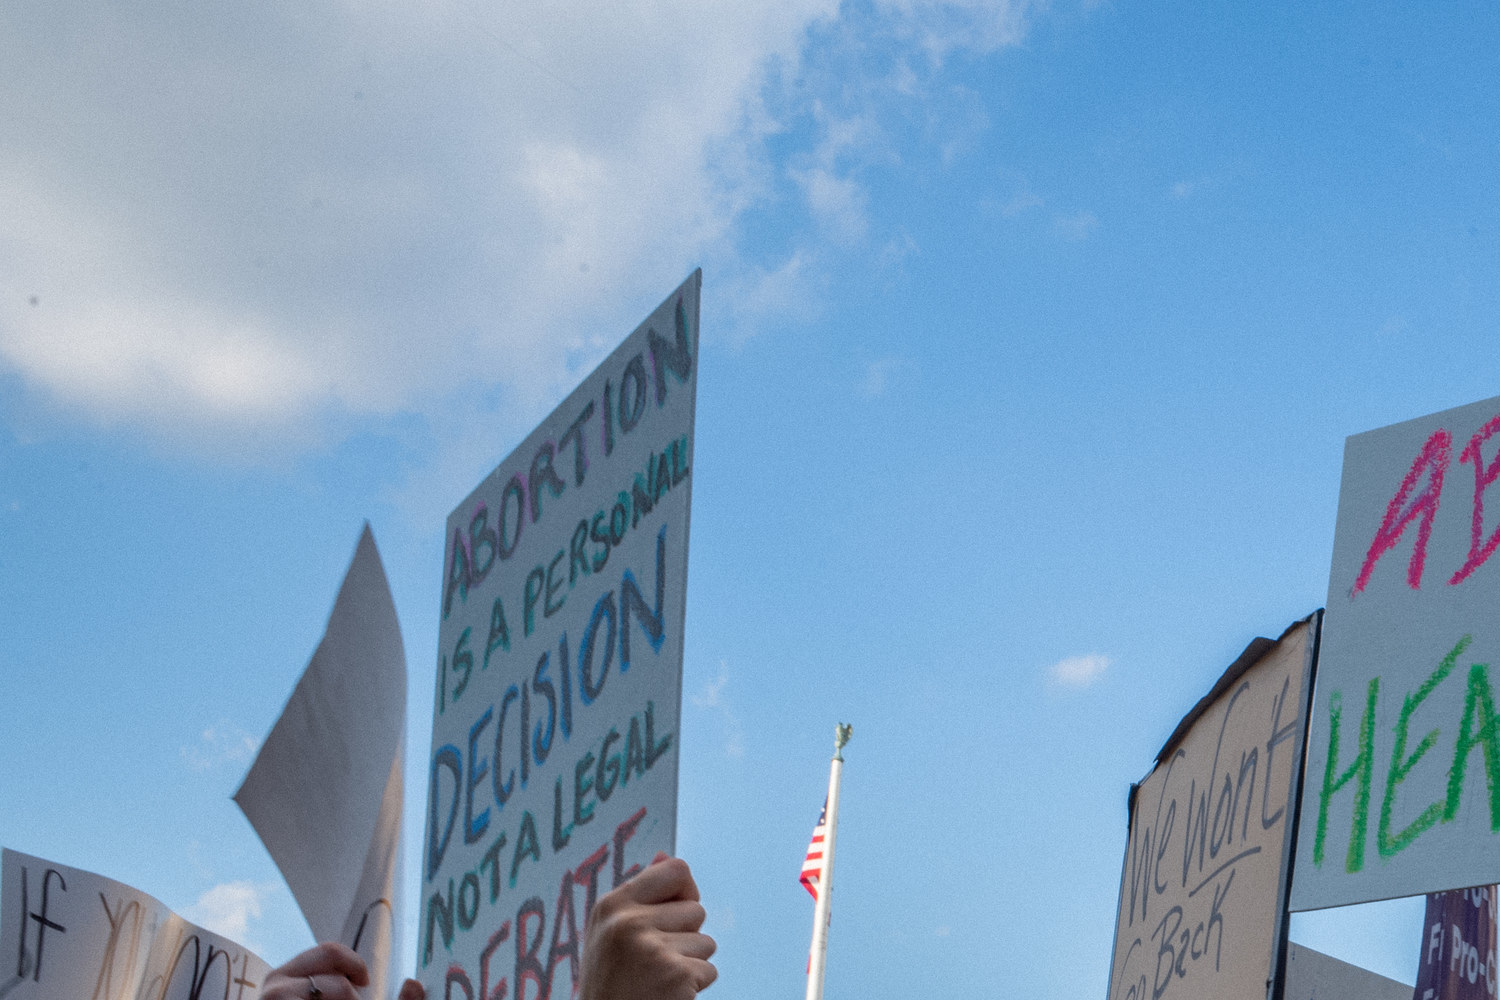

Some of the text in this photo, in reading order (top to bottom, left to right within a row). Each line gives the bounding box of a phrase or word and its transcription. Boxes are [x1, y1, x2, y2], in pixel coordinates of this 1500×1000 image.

[440, 434, 690, 713] IS A PERSONAL
[444, 297, 692, 620] ABORTION
[422, 701, 673, 968] NOT A LEGAL
[427, 524, 666, 882] DECISION
[1130, 748, 1186, 928] We
[17, 866, 67, 982] If
